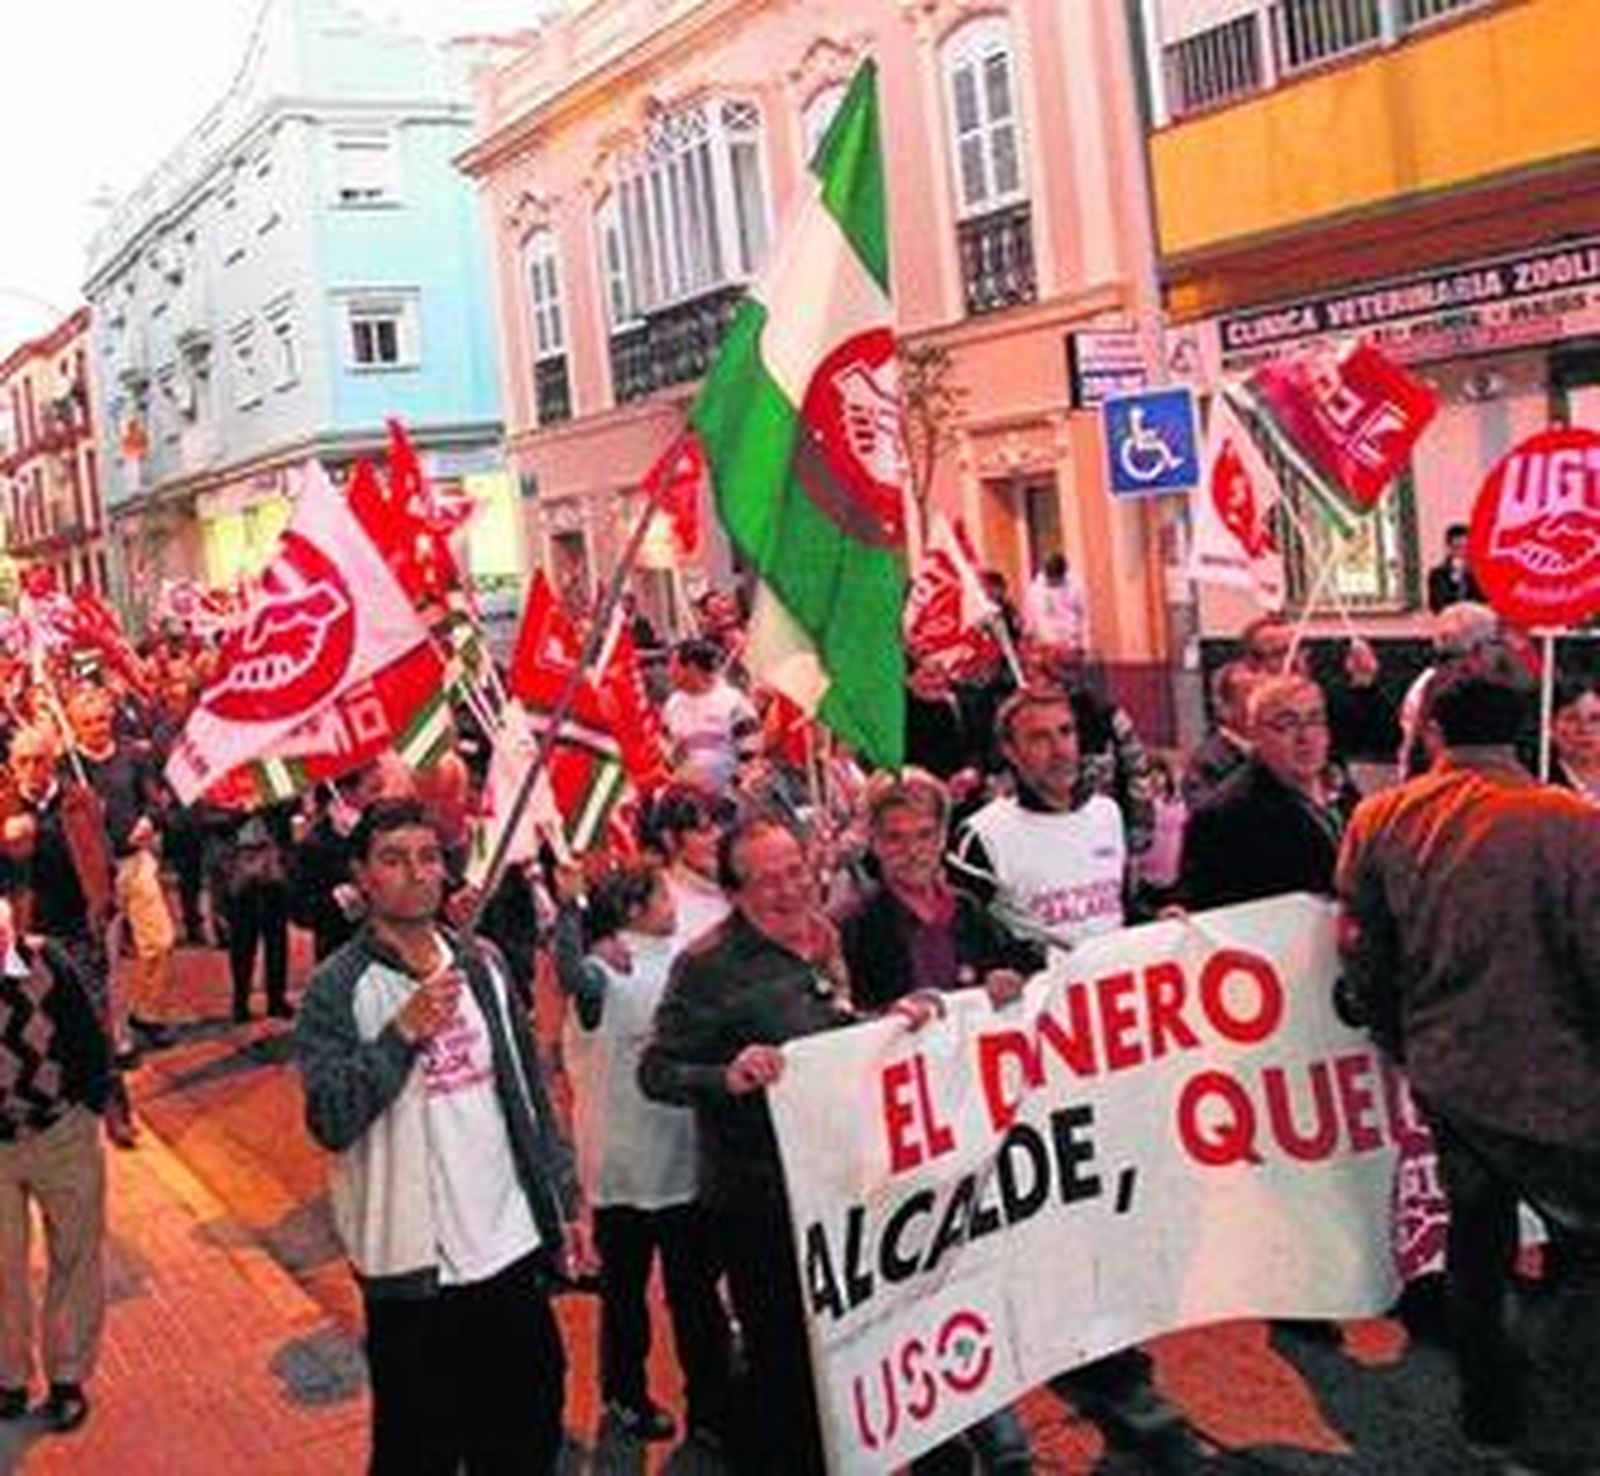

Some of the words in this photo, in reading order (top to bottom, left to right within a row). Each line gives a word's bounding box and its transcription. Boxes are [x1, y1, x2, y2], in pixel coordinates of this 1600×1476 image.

[882, 1054, 955, 1174] EL
[978, 949, 1285, 1133] DNERO
[806, 1105, 1136, 1320] ALCALDE,
[854, 1311, 993, 1449] USO
